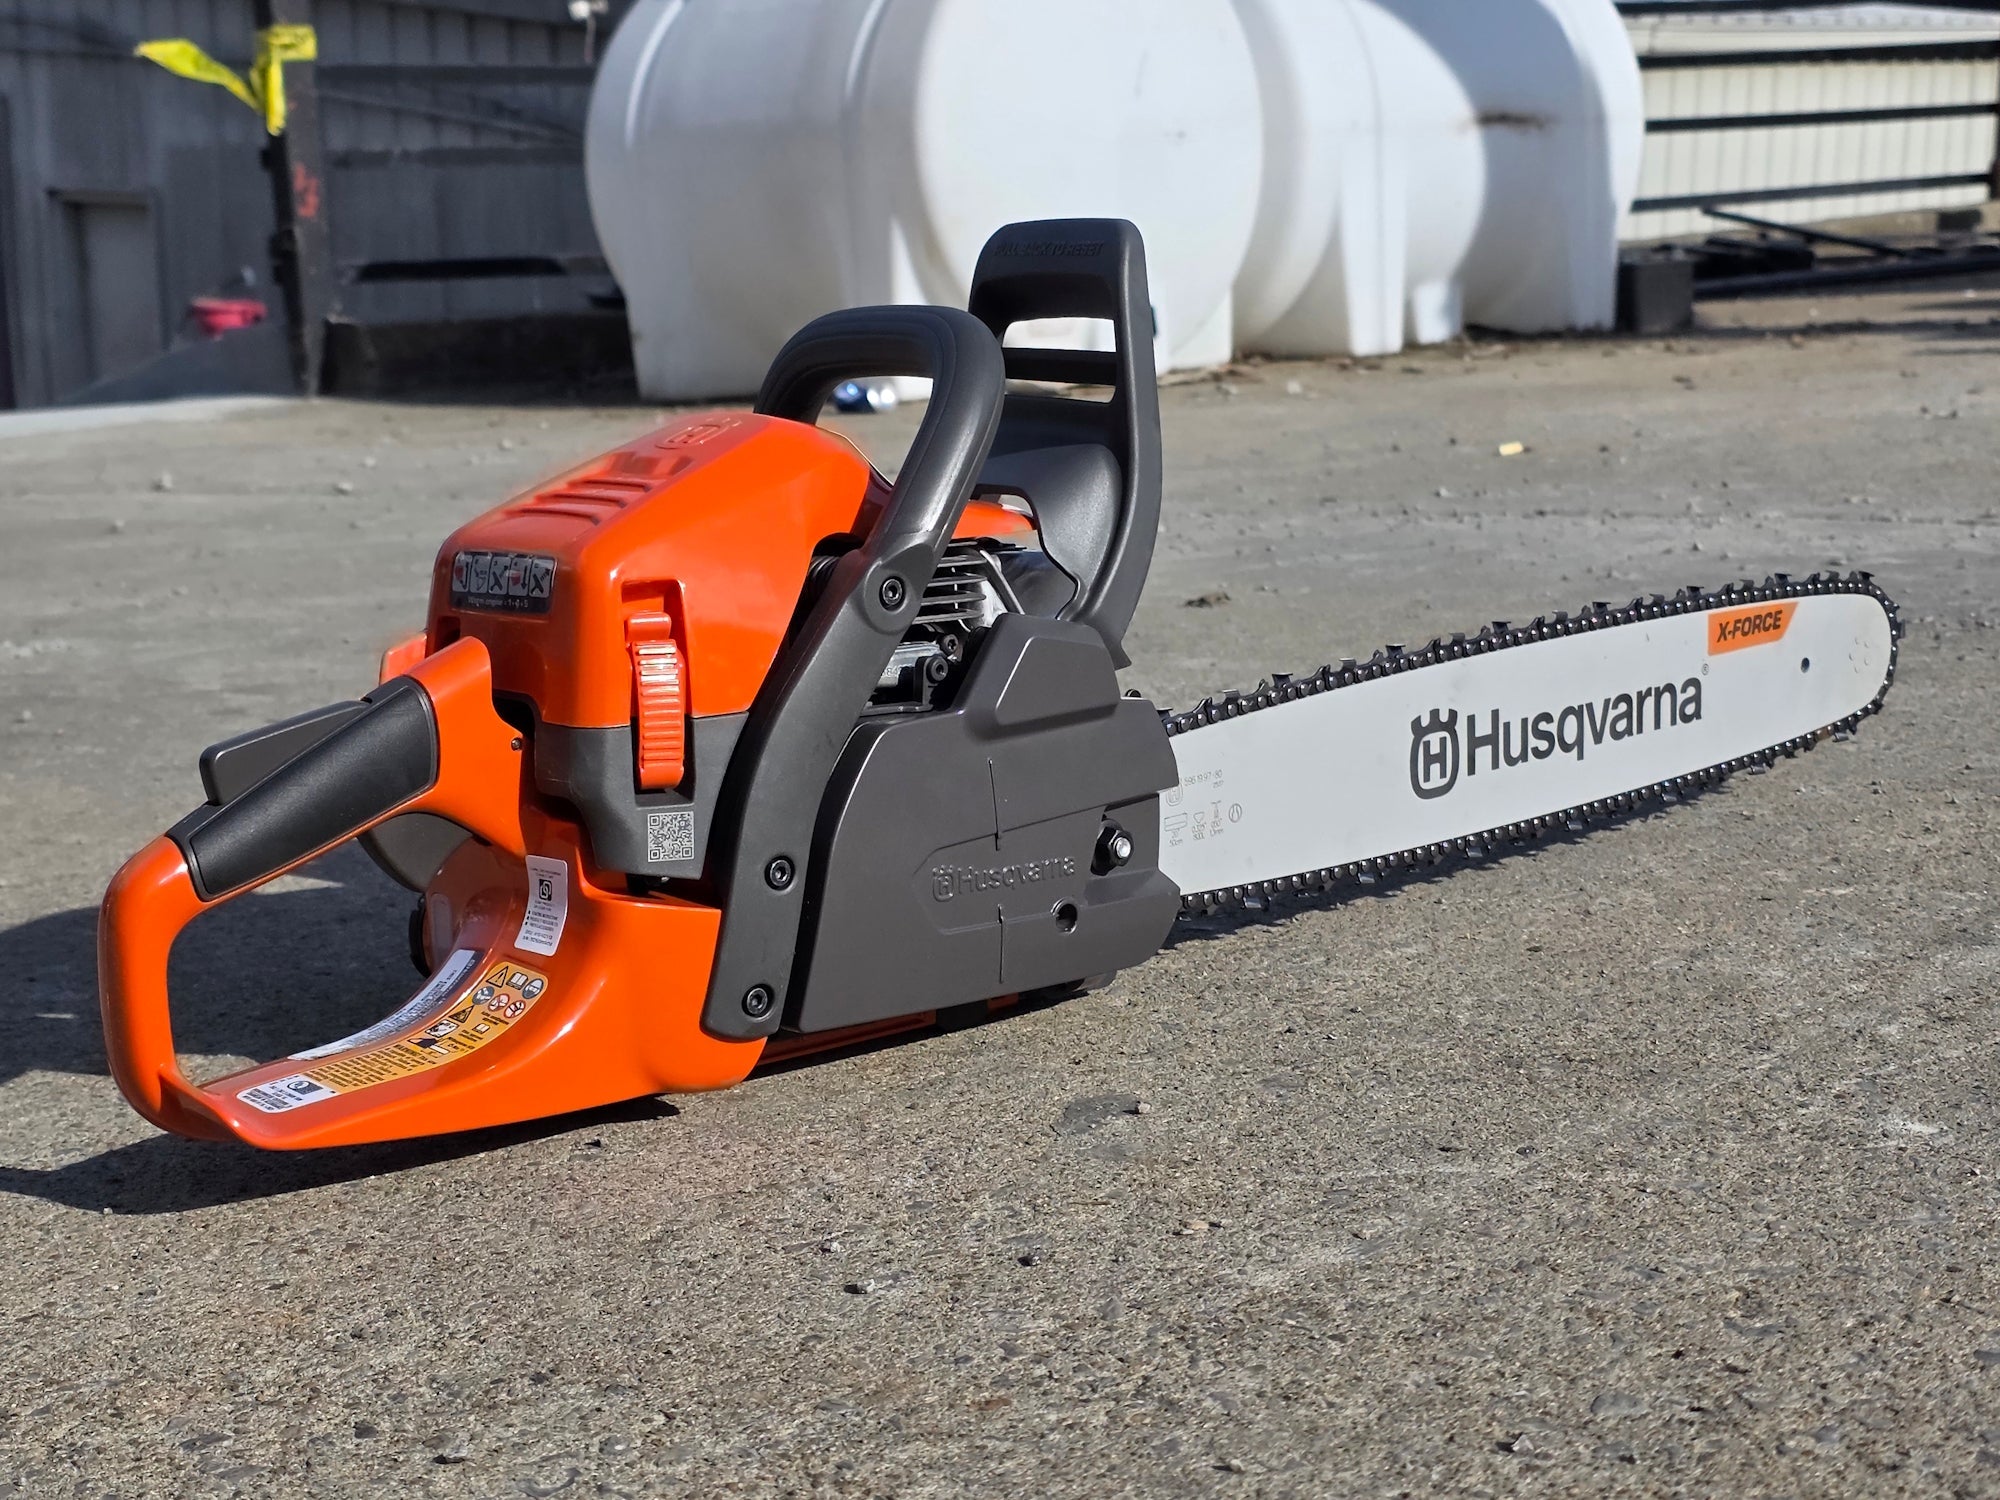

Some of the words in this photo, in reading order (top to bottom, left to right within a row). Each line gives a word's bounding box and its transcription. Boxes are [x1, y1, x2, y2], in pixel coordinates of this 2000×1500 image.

[1717, 610, 1784, 643] X-FORCE
[1466, 677, 1702, 776] Husqvarna
[958, 856, 1075, 894] Husqvarna
